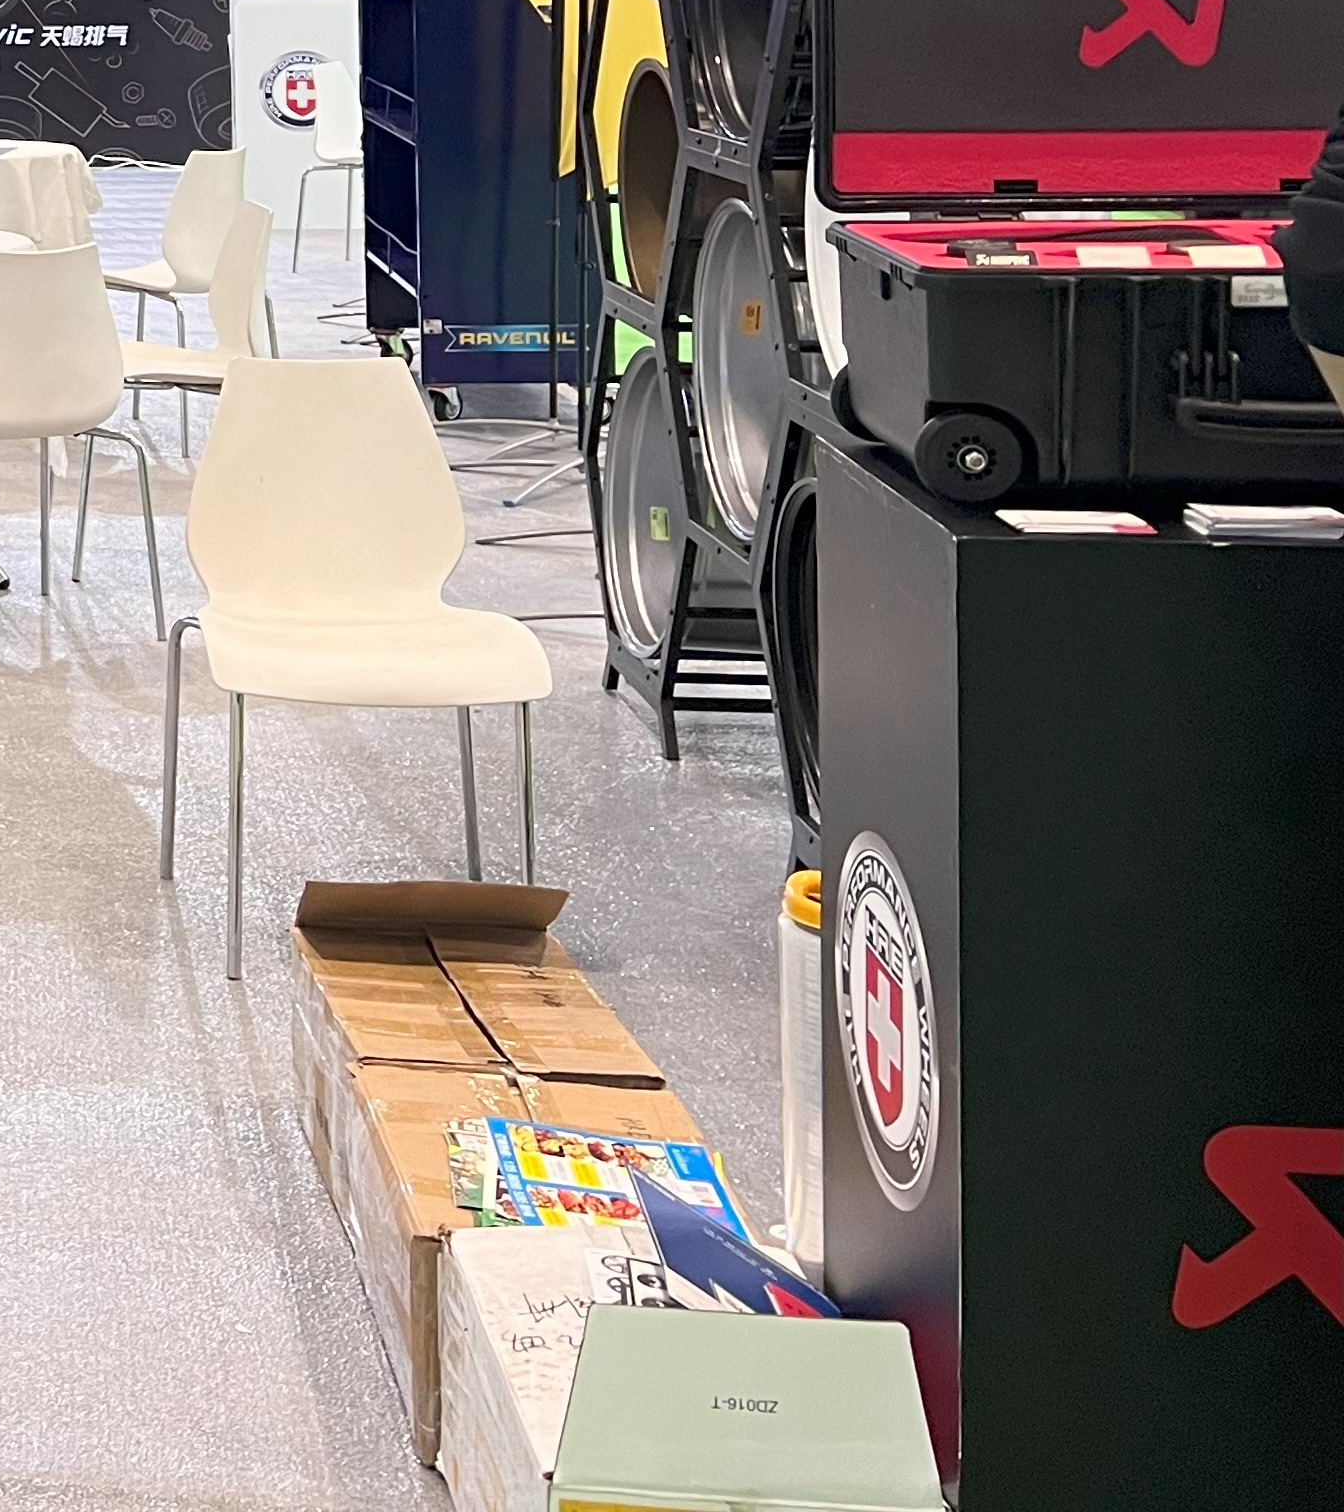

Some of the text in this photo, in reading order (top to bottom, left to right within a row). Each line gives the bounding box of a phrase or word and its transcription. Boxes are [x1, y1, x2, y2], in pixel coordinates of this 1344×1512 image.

[459, 331, 576, 345] RAVENOL
[865, 906, 904, 982] HRE
[710, 1395, 779, 1415] ZD016-T
